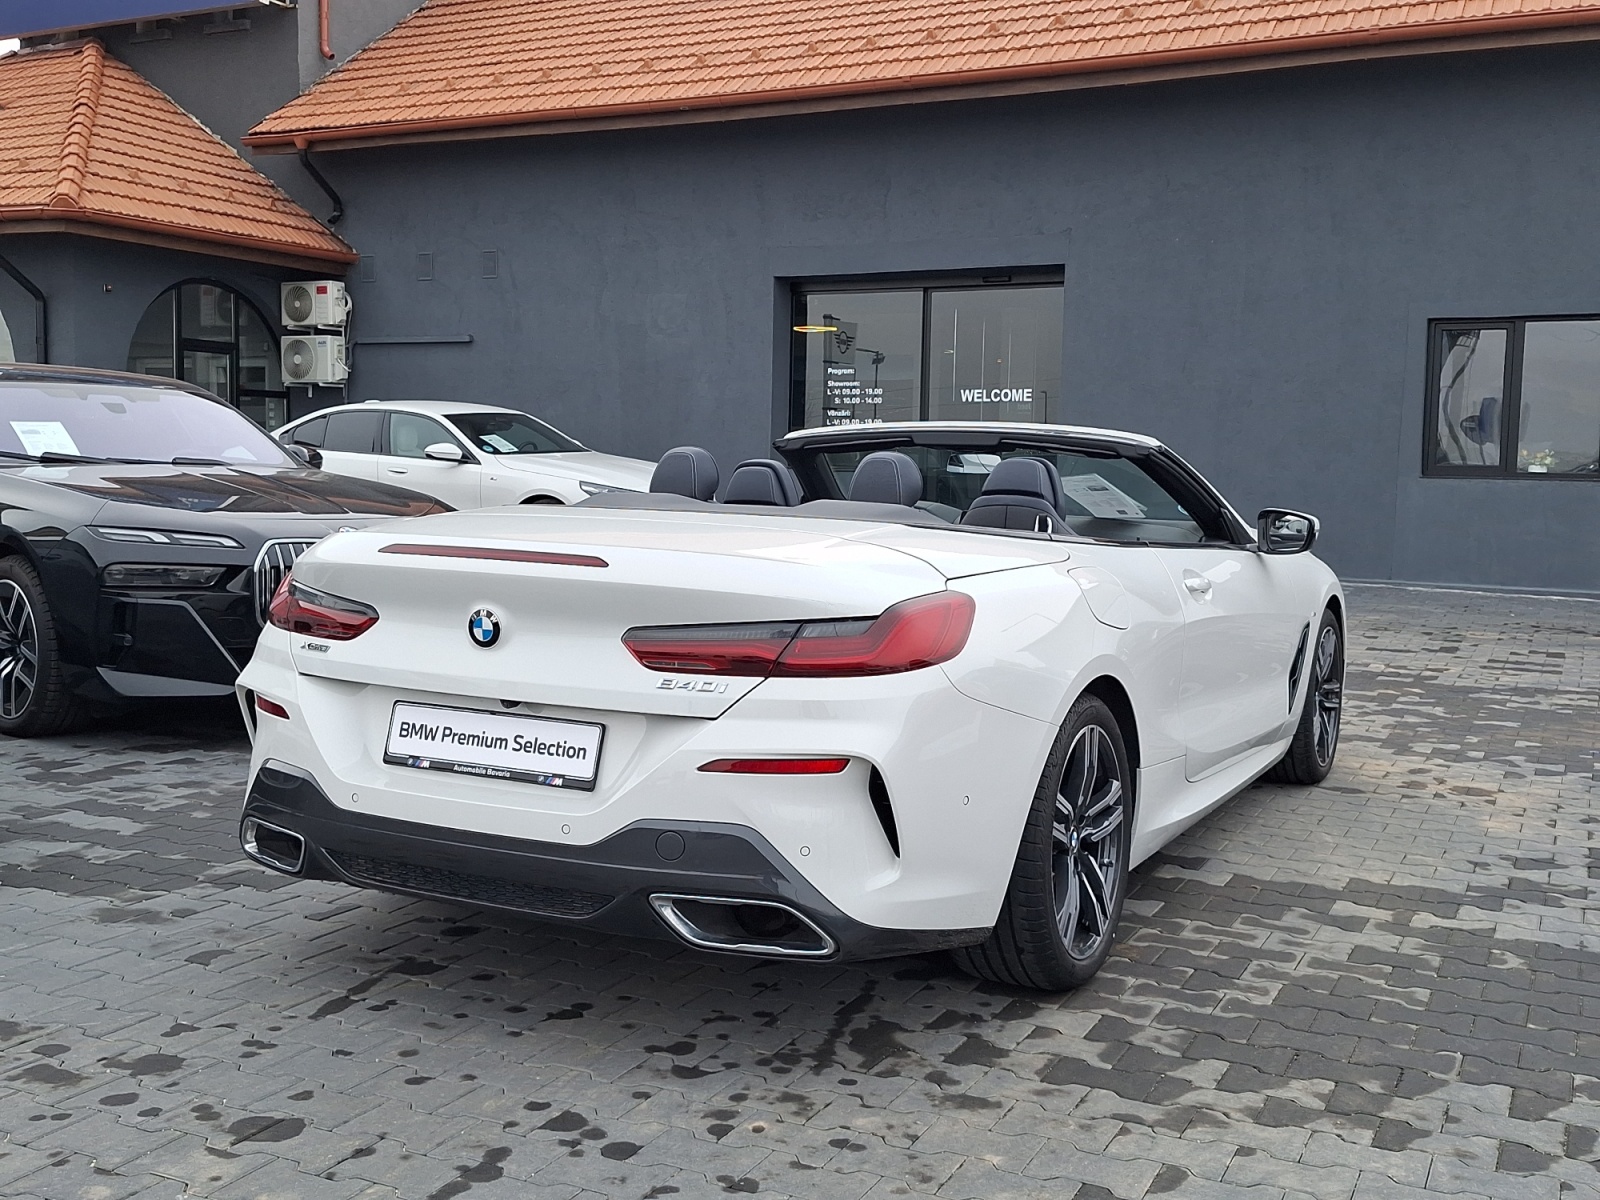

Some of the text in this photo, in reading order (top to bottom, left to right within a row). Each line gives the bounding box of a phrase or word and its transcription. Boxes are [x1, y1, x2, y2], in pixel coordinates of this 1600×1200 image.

[827, 367, 855, 375] Program:
[960, 388, 1033, 402] WELCOME
[655, 678, 729, 694] 840i
[398, 721, 588, 760] BMW Premium Selection
[453, 764, 511, 778] Automobile Bavaria
